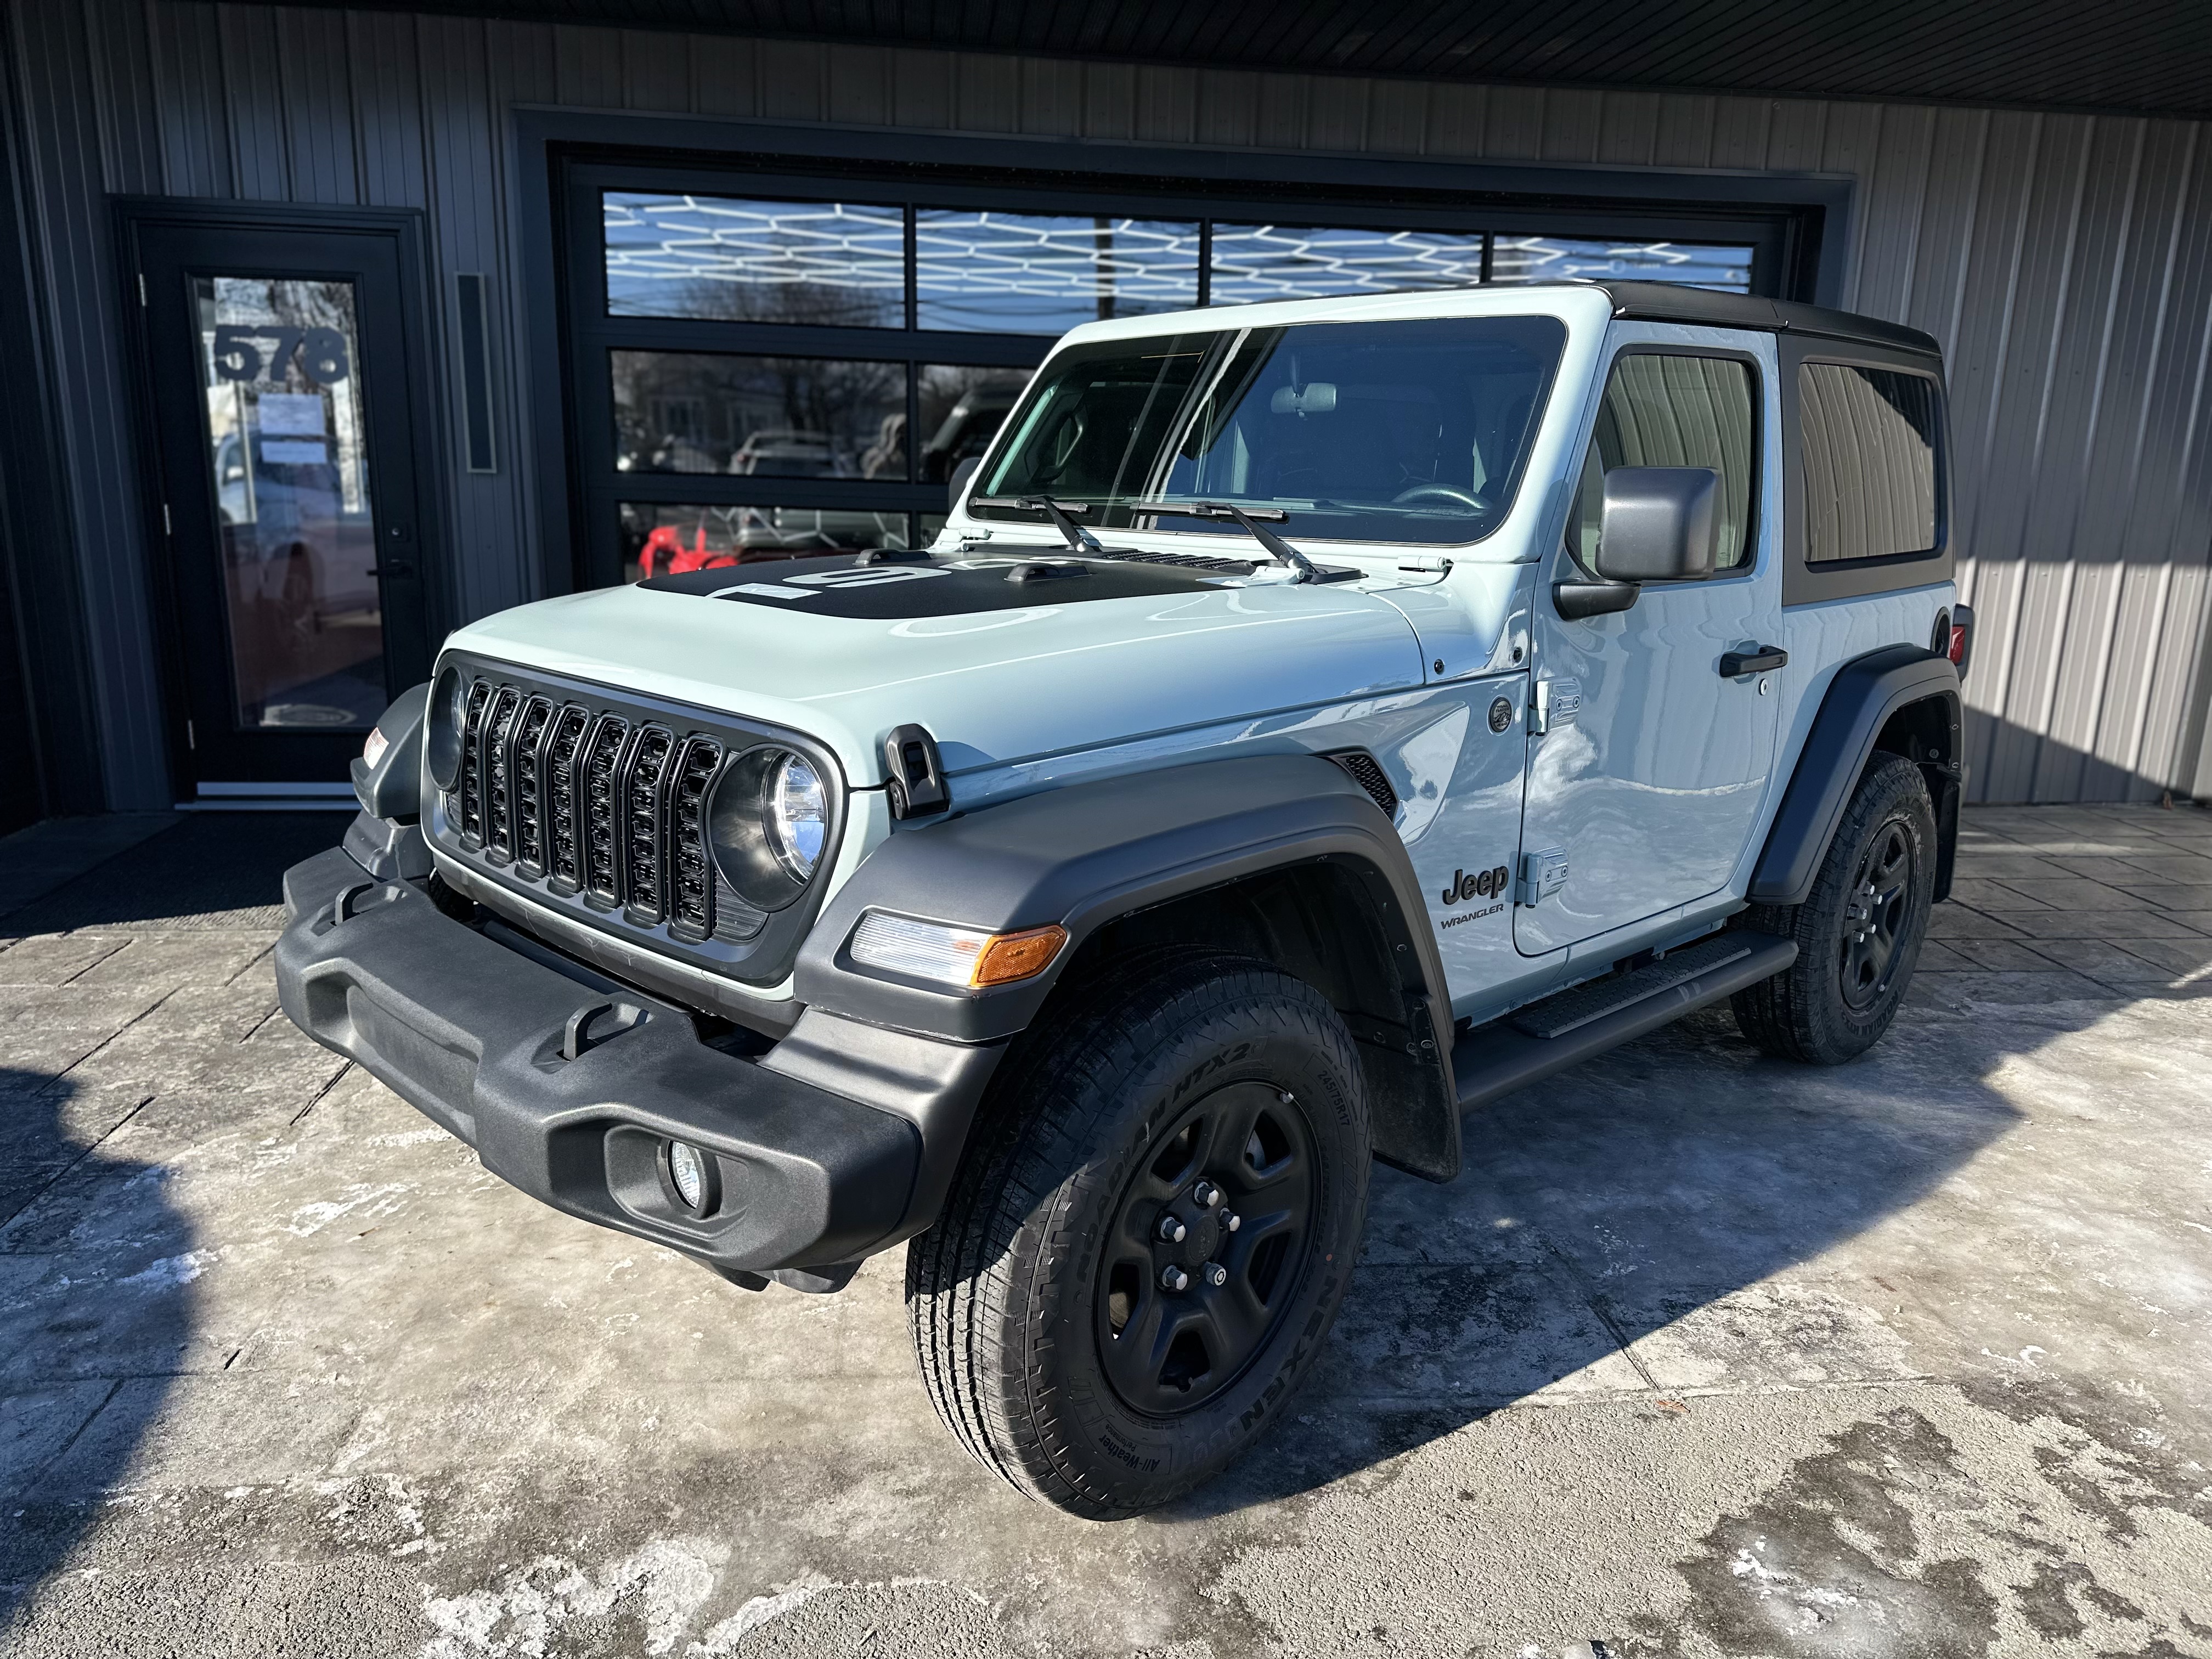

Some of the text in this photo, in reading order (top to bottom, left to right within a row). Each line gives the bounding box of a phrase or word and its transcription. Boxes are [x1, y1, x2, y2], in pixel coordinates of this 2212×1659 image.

[215, 325, 349, 384] 578
[1442, 866, 1509, 905] Jeep
[1440, 904, 1504, 929] WRANGLER
[1317, 1070, 1351, 1126] 245/75R17
[1076, 1097, 1166, 1283] ROADIAN
[1171, 1043, 1251, 1104] HTX2
[1239, 1276, 1338, 1432] NEXEN
[1098, 1434, 1160, 1472] All-Weather
[1105, 1424, 1137, 1452] Performance
